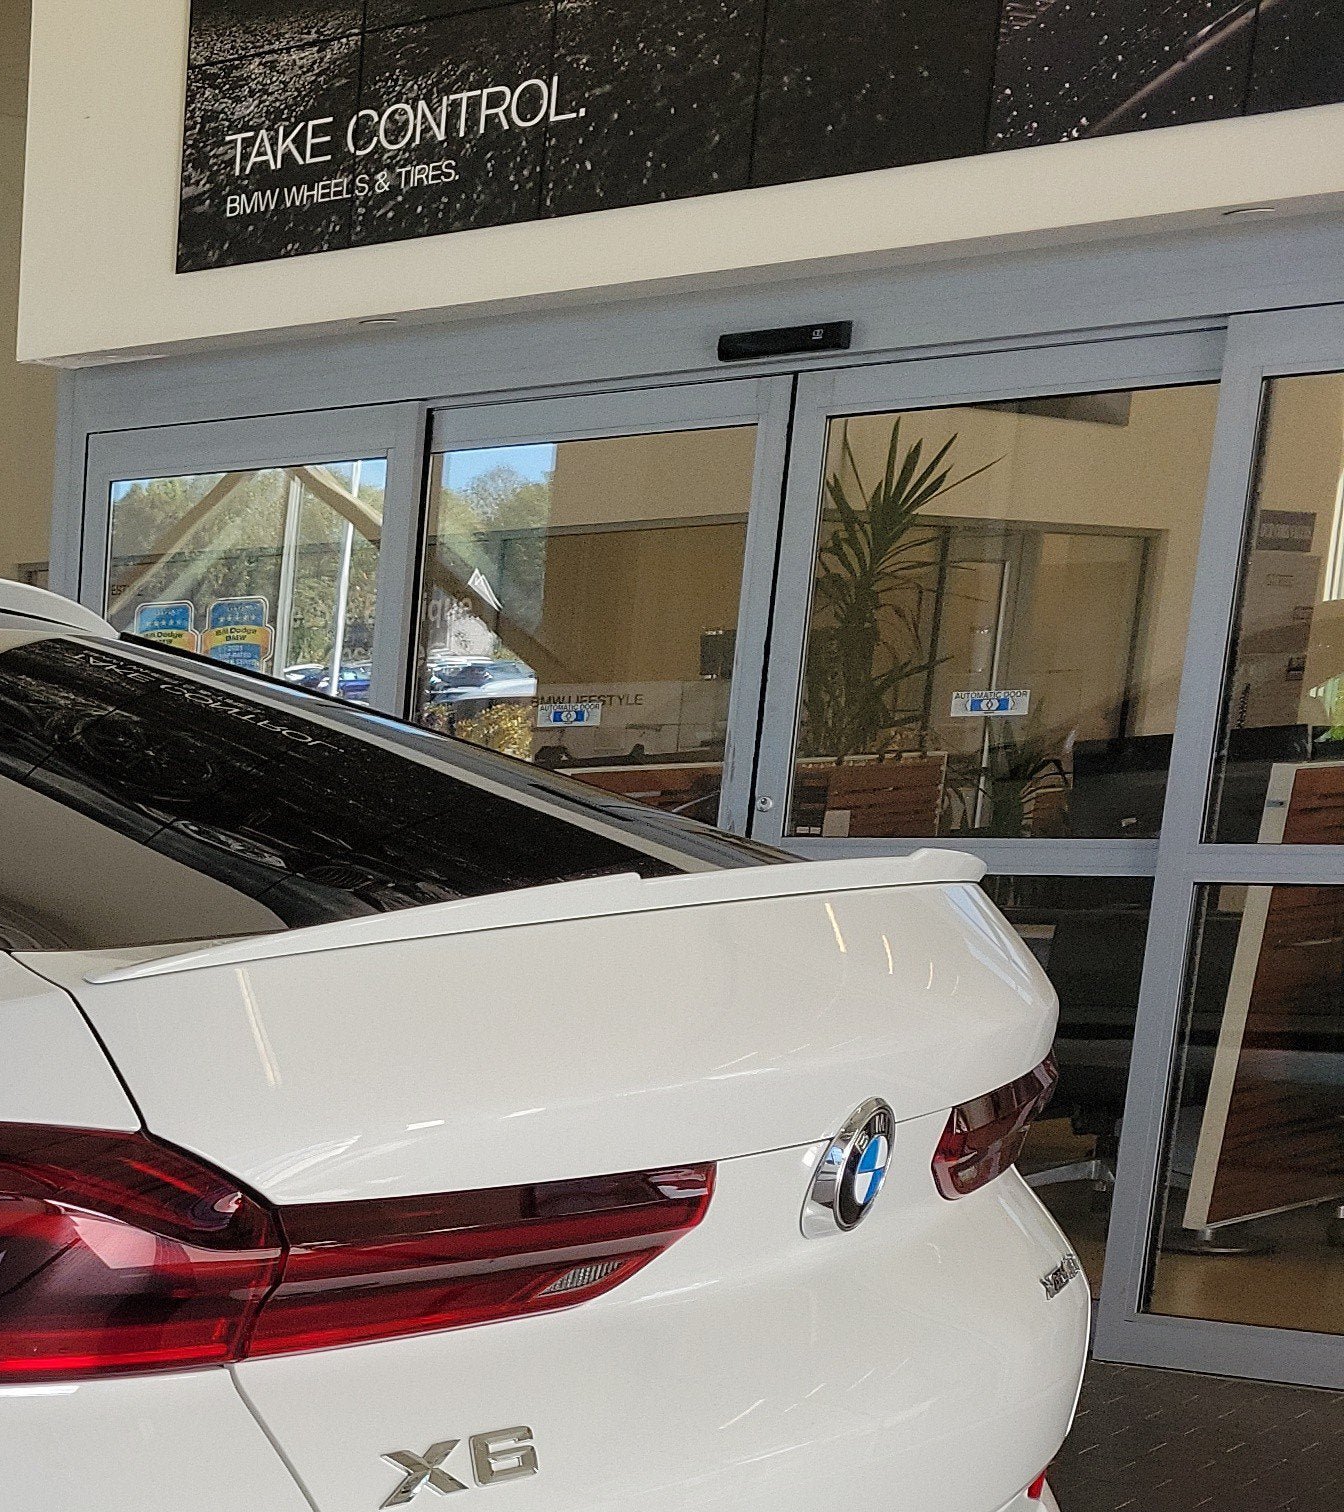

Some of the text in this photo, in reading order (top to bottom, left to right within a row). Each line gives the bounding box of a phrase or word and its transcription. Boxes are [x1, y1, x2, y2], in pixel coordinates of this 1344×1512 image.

[225, 75, 586, 177] TAKE CONTROL.
[226, 160, 460, 218] BMW WHEELS & TIRES.
[229, 626, 258, 636] Dodge
[225, 634, 248, 642] BMW
[954, 690, 1028, 700] AUTOMATIC DOOR
[540, 702, 600, 712] AUTOMATIC DOOR
[379, 1425, 539, 1511] X6
